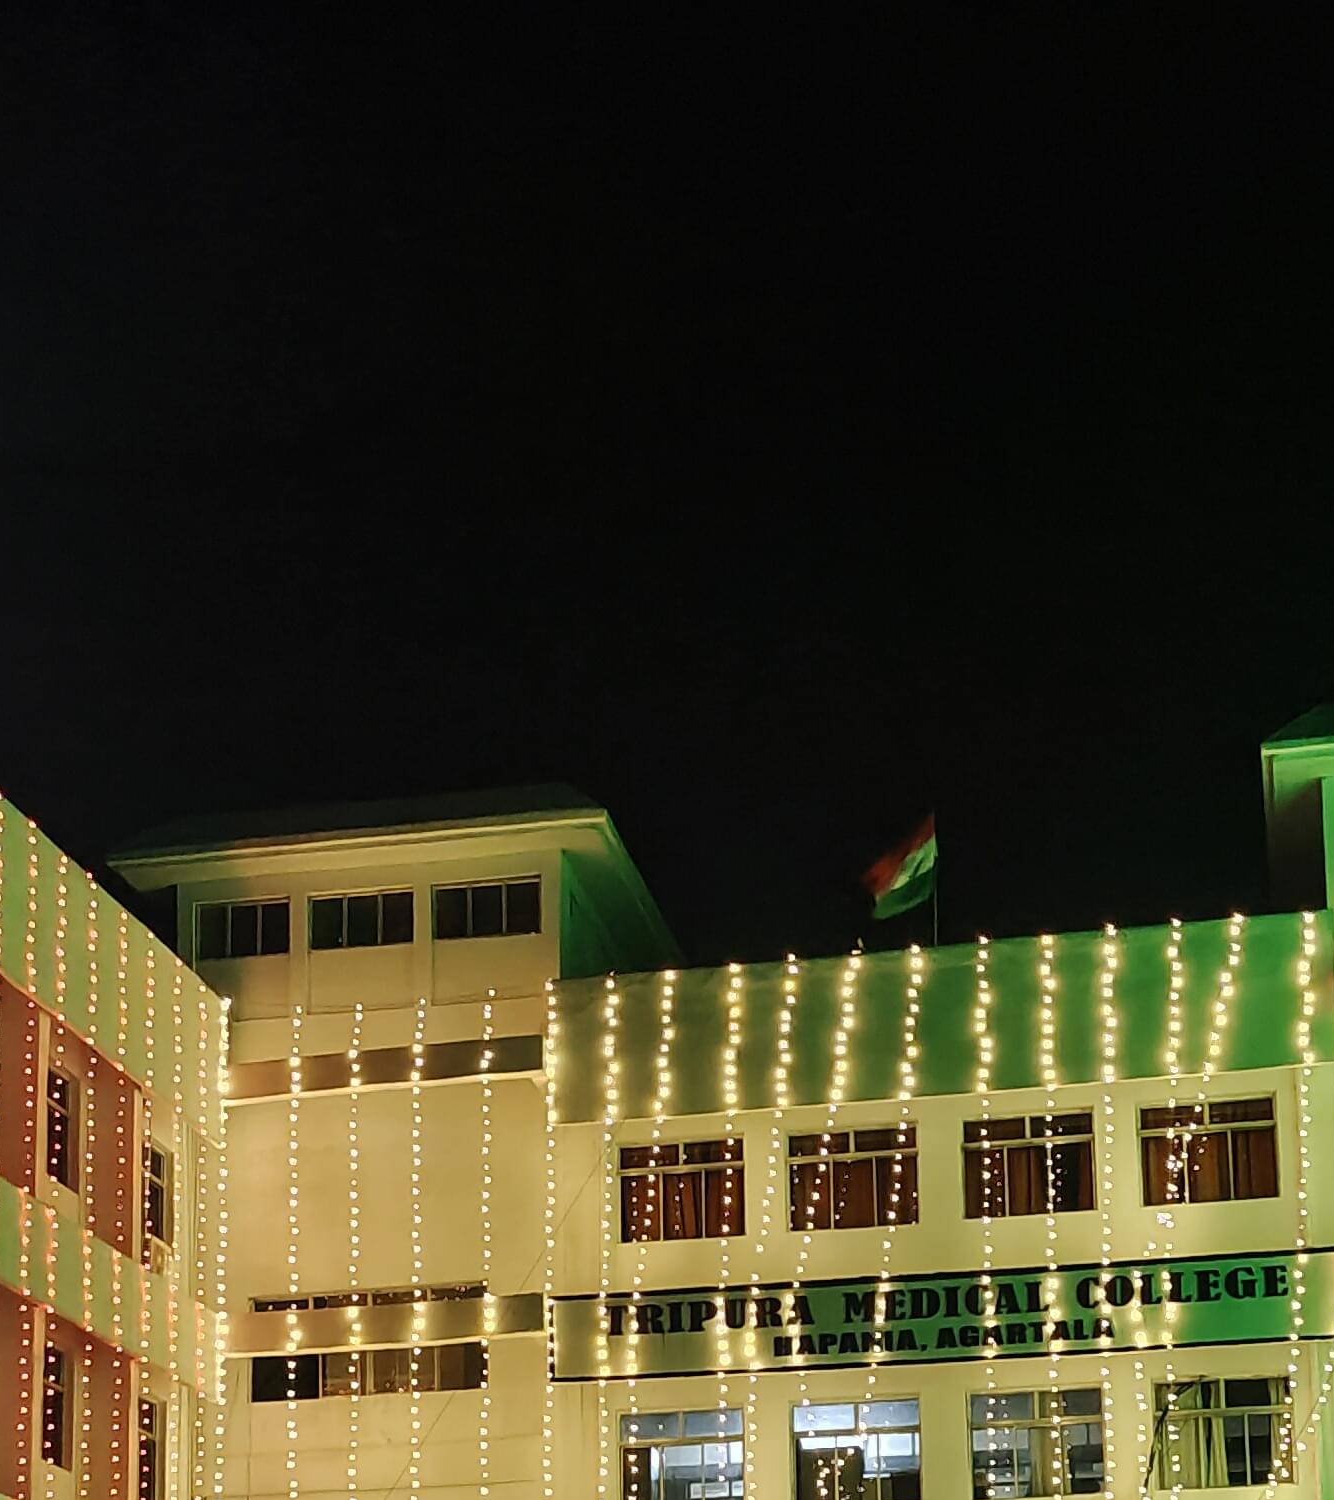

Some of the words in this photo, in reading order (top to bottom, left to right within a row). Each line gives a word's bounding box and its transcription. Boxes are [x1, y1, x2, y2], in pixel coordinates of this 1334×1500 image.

[607, 1295, 815, 1337] TRIPURA
[843, 1280, 1051, 1325] MEDICAL
[1075, 1263, 1290, 1310] COLLEGE
[934, 1317, 1116, 1348] AGARTALA
